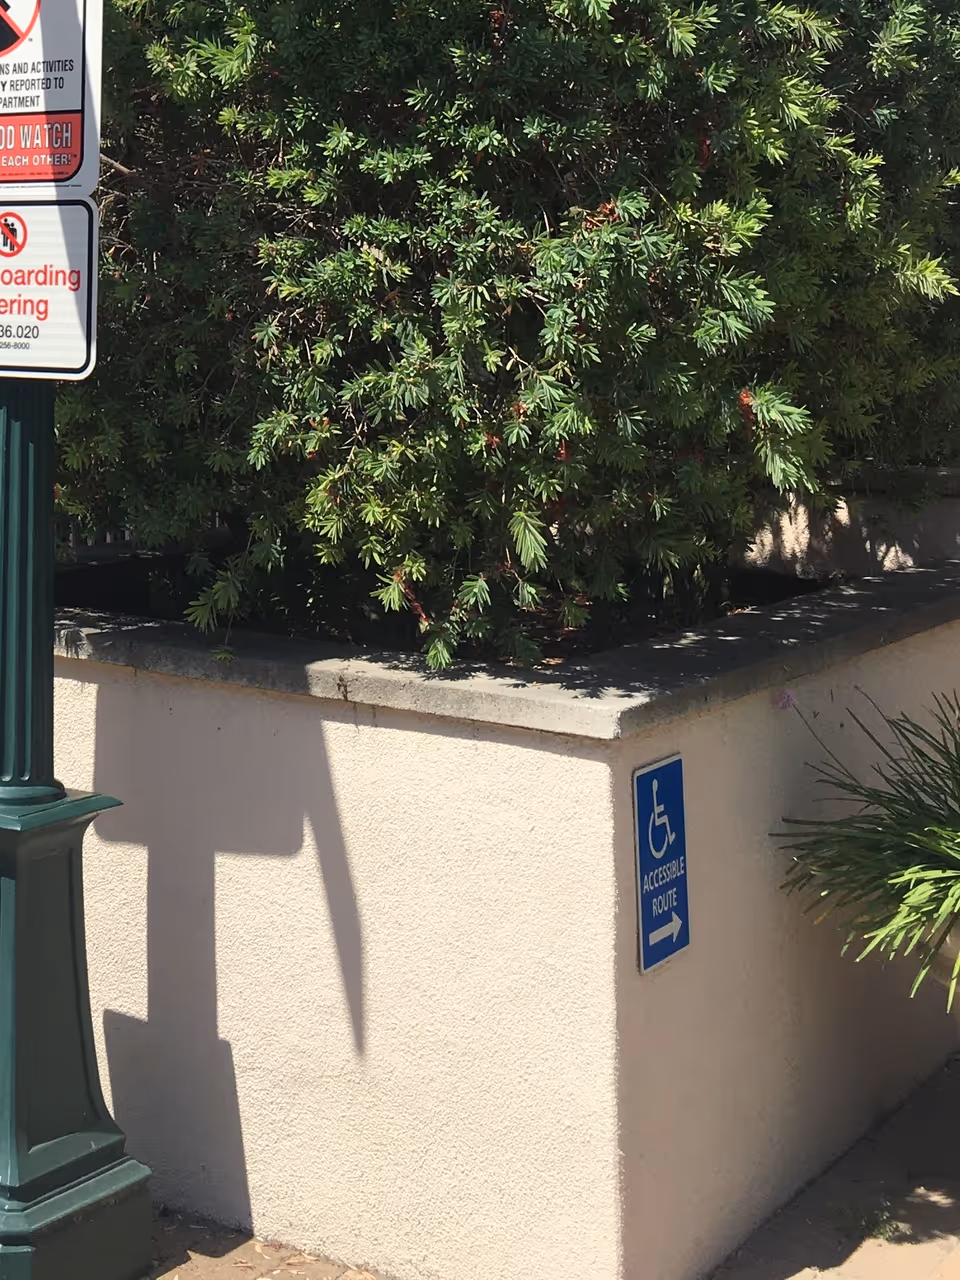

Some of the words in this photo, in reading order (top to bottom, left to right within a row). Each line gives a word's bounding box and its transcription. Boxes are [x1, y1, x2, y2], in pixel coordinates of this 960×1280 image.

[12, 61, 29, 75] AND
[31, 59, 74, 74] ACTIVITIES
[9, 77, 51, 92] REPORTED
[53, 77, 65, 90] TO
[20, 122, 72, 149] WATCH
[1, 155, 29, 167] EACH
[32, 153, 72, 166] OTHER!
[0, 341, 30, 350] 256-8000
[643, 856, 685, 895] ACCESSIBLE
[652, 887, 678, 917] ROUTE
